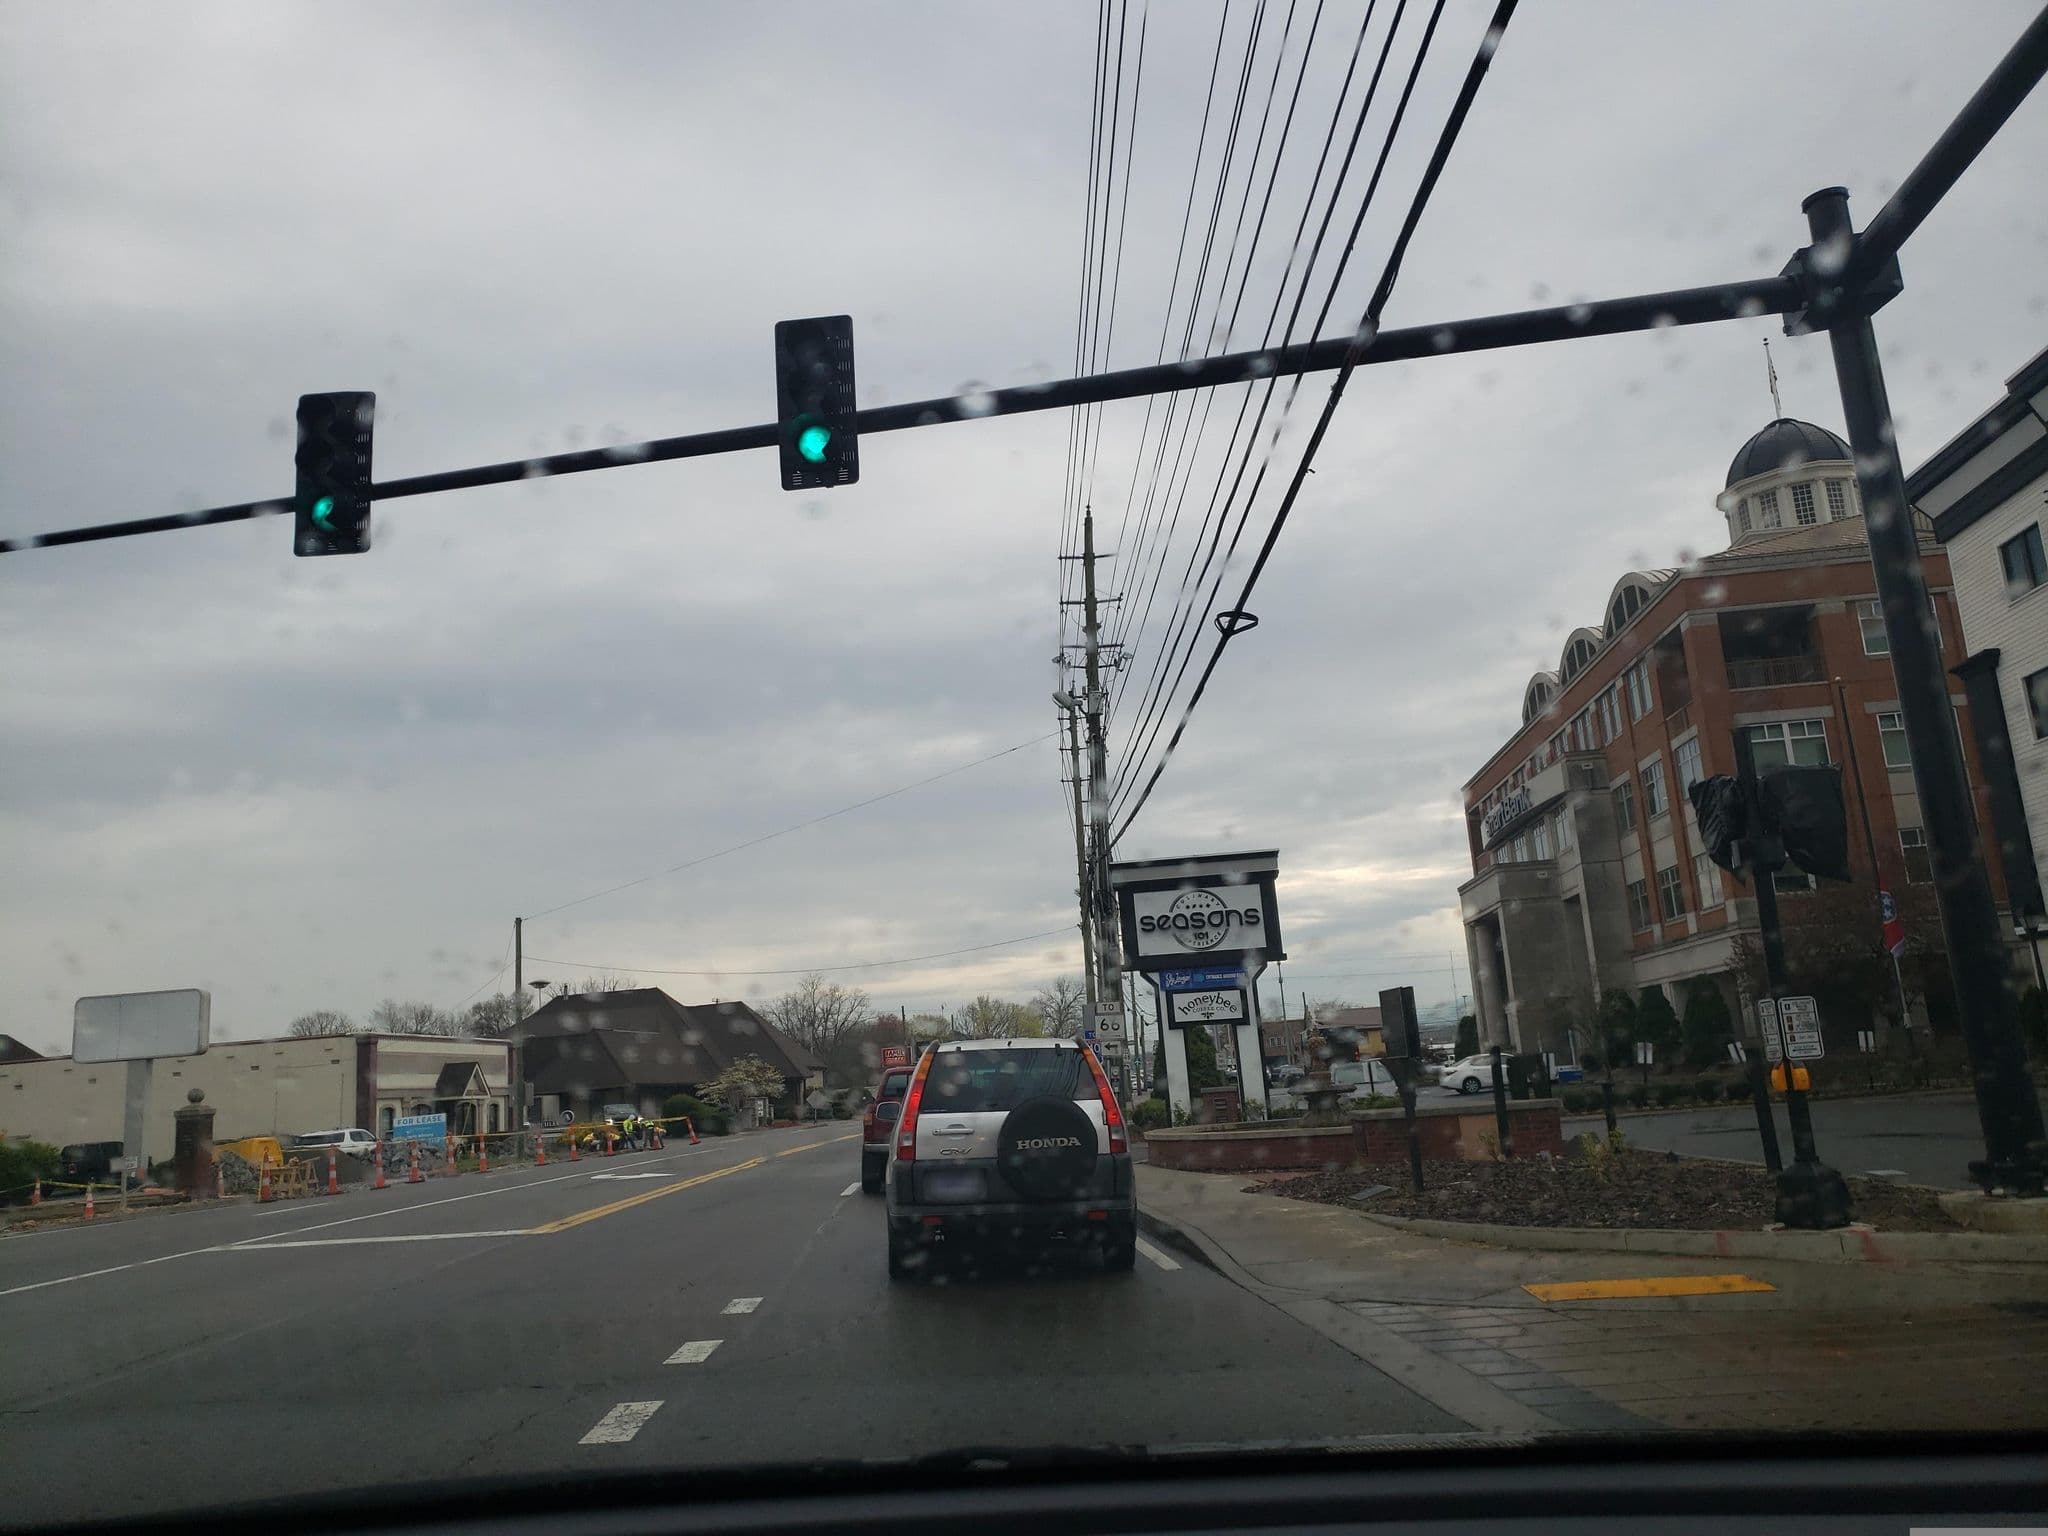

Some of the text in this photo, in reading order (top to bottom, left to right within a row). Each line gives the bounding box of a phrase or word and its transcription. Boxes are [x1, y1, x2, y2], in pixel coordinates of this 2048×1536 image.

[1139, 907, 1260, 932] seasons
[1178, 992, 1238, 1015] honeybee
[397, 1114, 442, 1126] FOR LEASE
[1016, 1137, 1083, 1150] HONDA
